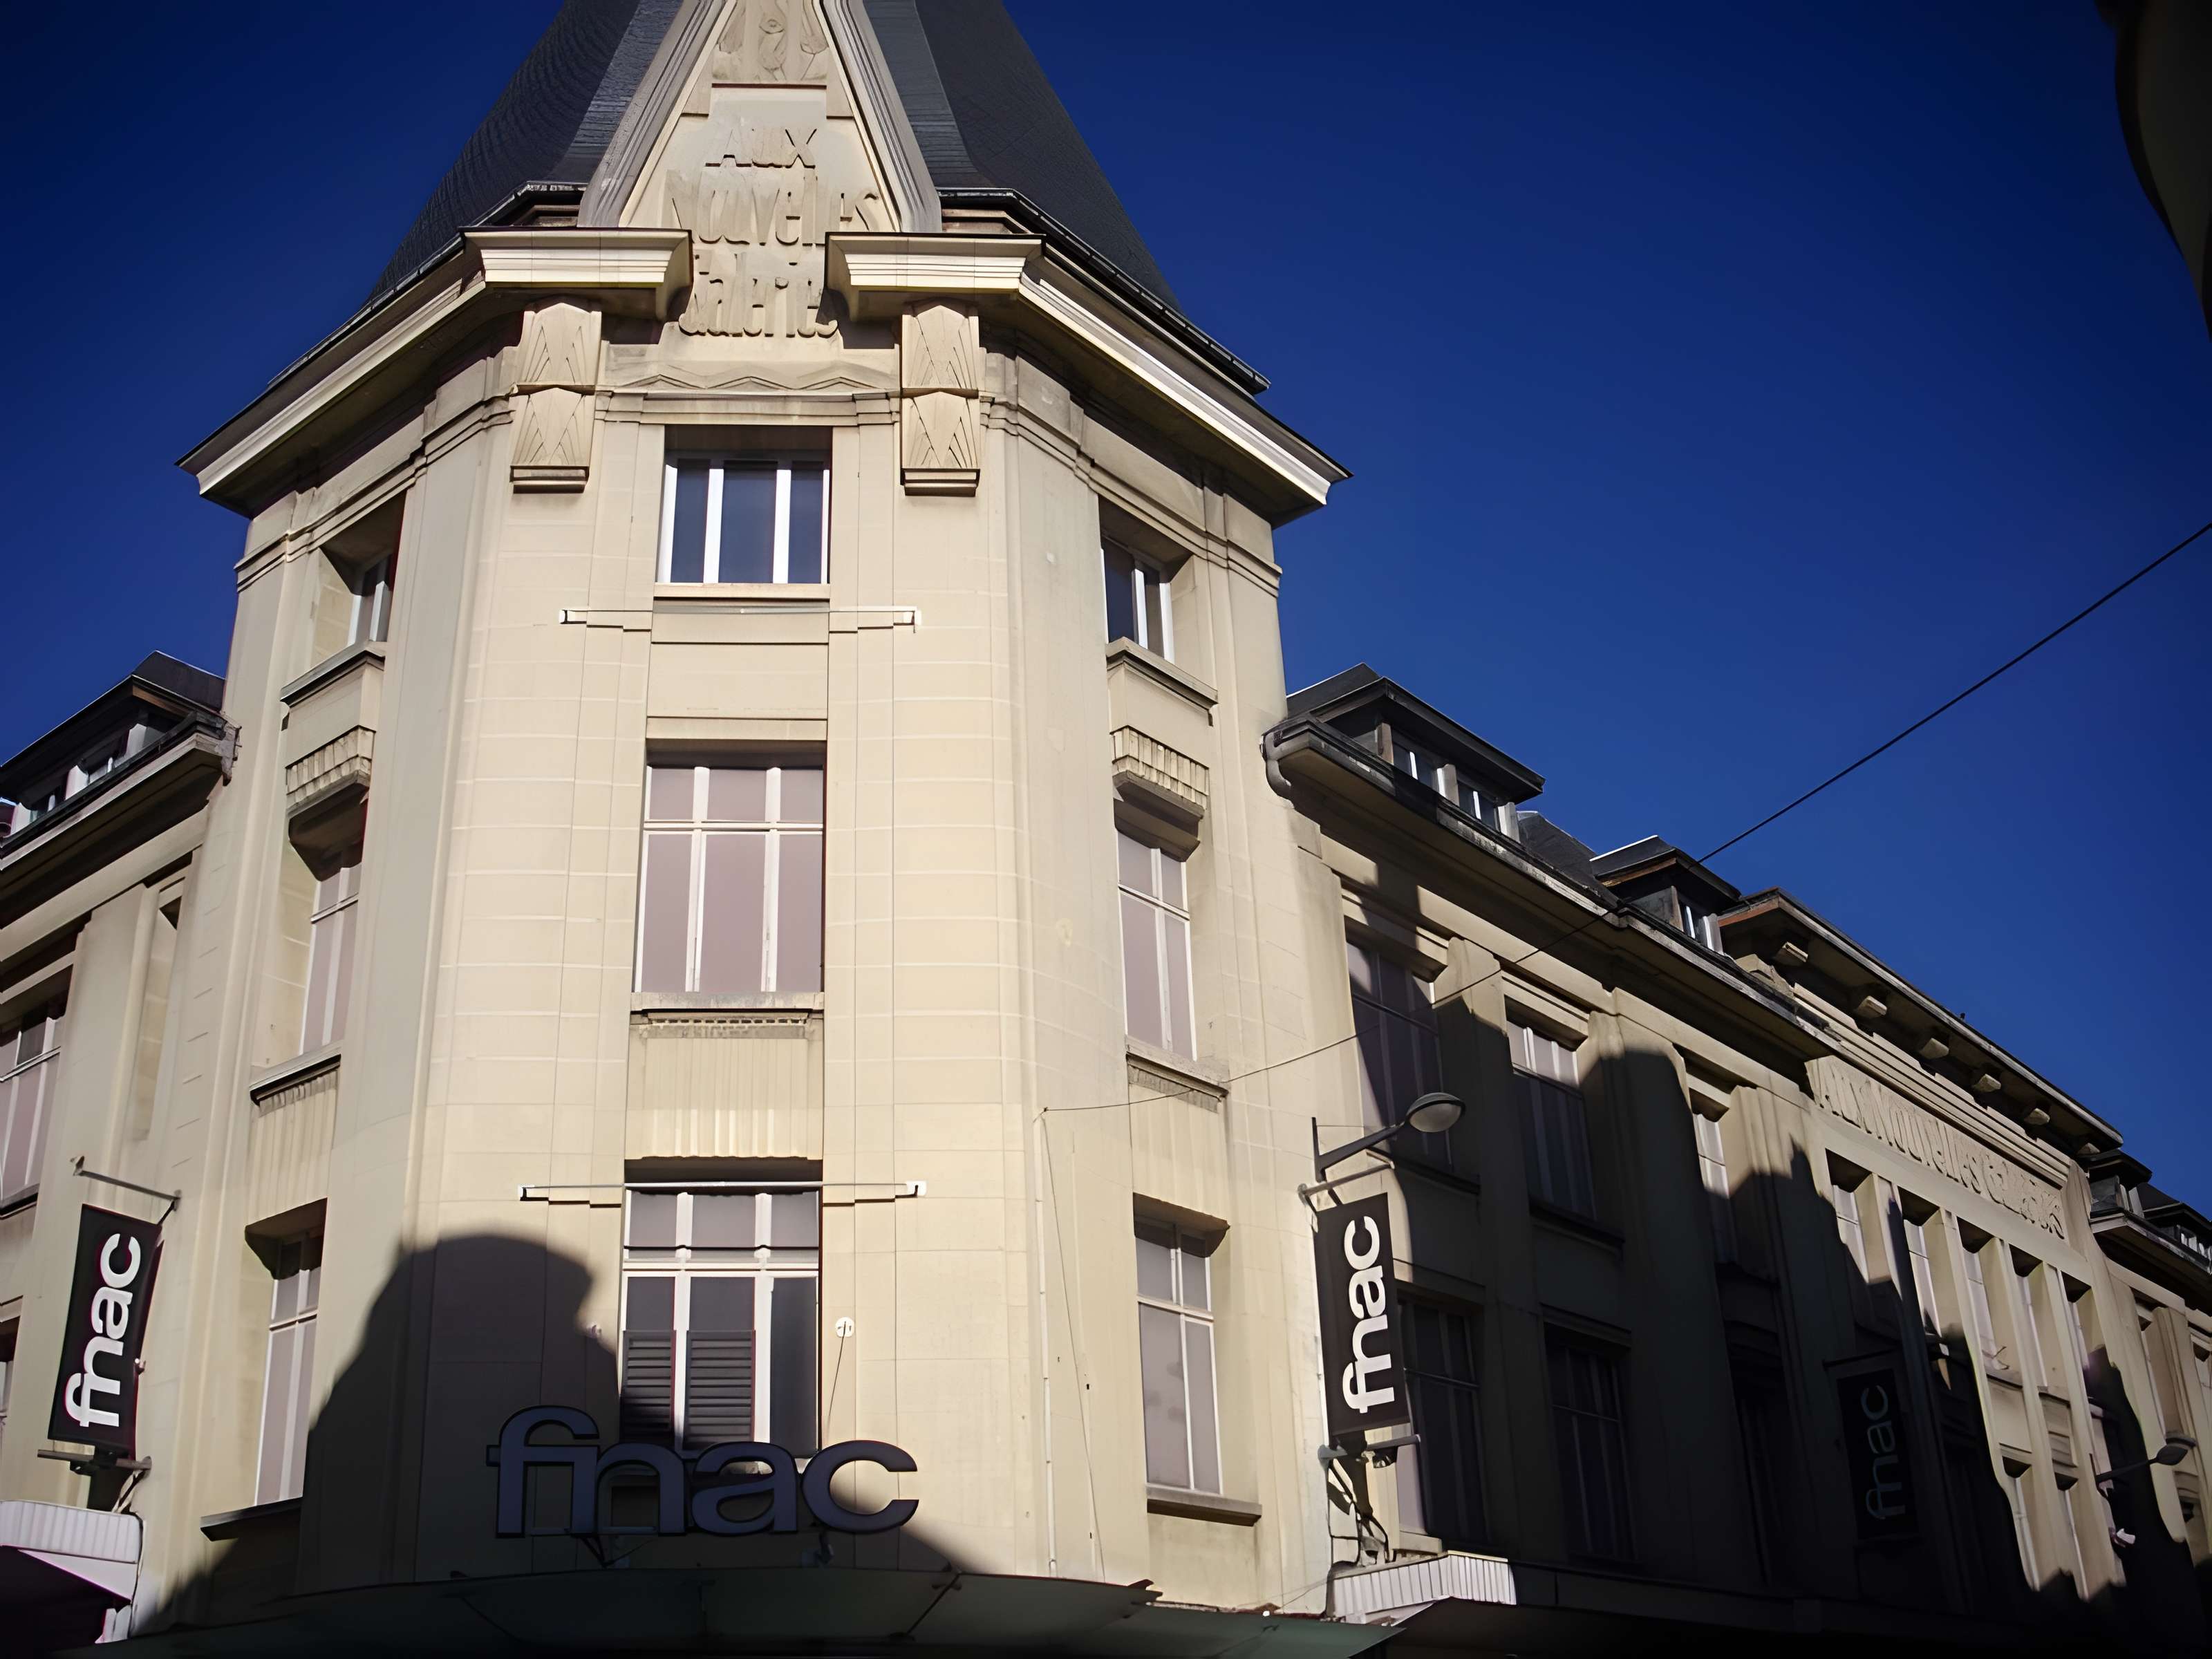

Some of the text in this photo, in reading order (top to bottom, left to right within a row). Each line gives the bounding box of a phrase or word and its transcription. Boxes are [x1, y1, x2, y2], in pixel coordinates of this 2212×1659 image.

[66, 1232, 141, 1427] fnac
[1343, 1215, 1395, 1414] fnac
[486, 1405, 919, 1539] fnac
[1860, 1383, 1906, 1521] fnac
